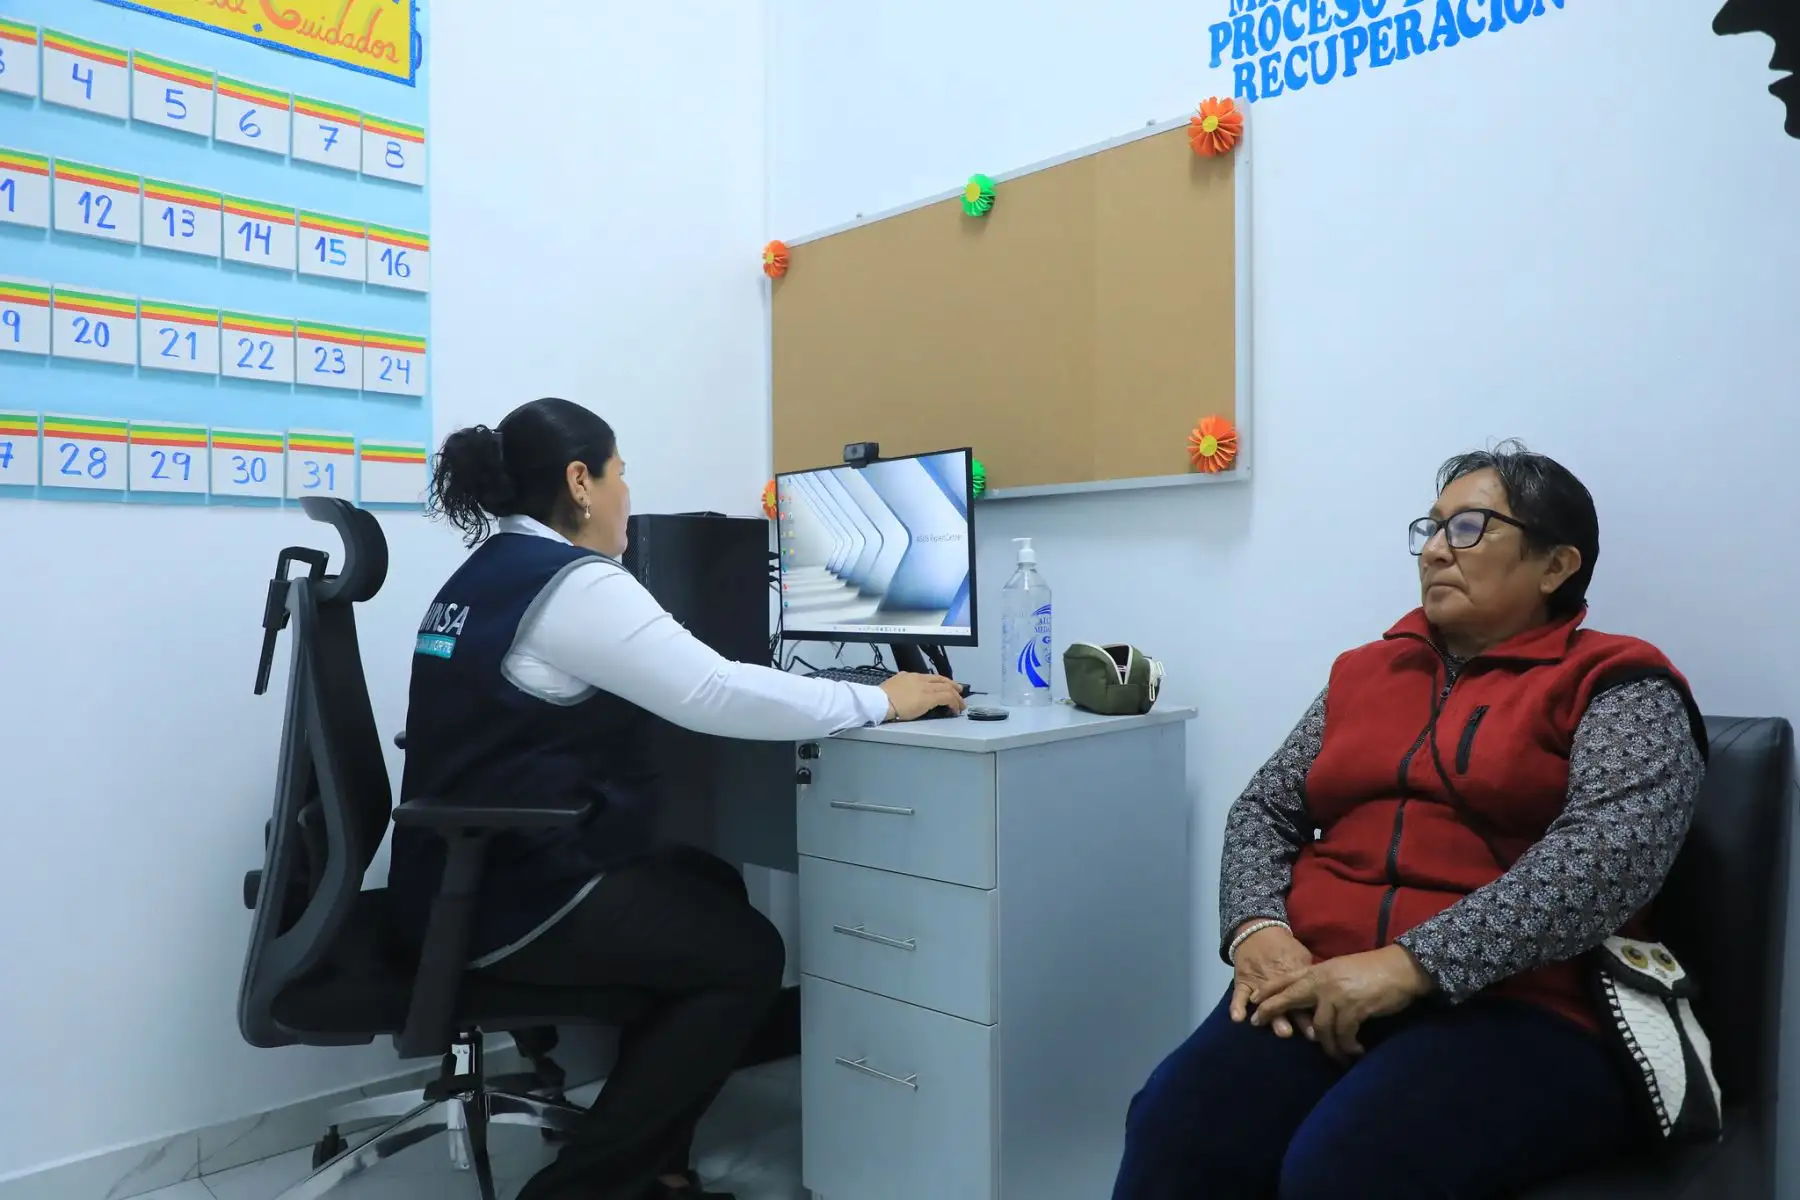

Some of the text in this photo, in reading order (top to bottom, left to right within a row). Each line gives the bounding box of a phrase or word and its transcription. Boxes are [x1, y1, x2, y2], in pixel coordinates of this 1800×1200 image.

[72, 63, 405, 169] 4 5 6 7 8
[78, 191, 116, 231] 12
[162, 207, 195, 238] 13
[238, 221, 272, 255] 14
[315, 236, 347, 266] 15
[381, 248, 411, 278] 16
[72, 316, 110, 348] 20
[159, 327, 197, 360] 21
[237, 338, 275, 370] 22
[314, 346, 346, 374] 23
[379, 356, 411, 385] 24
[60, 442, 107, 479] 28
[150, 451, 191, 481] 29
[232, 456, 267, 485] 30
[303, 461, 335, 491] 31
